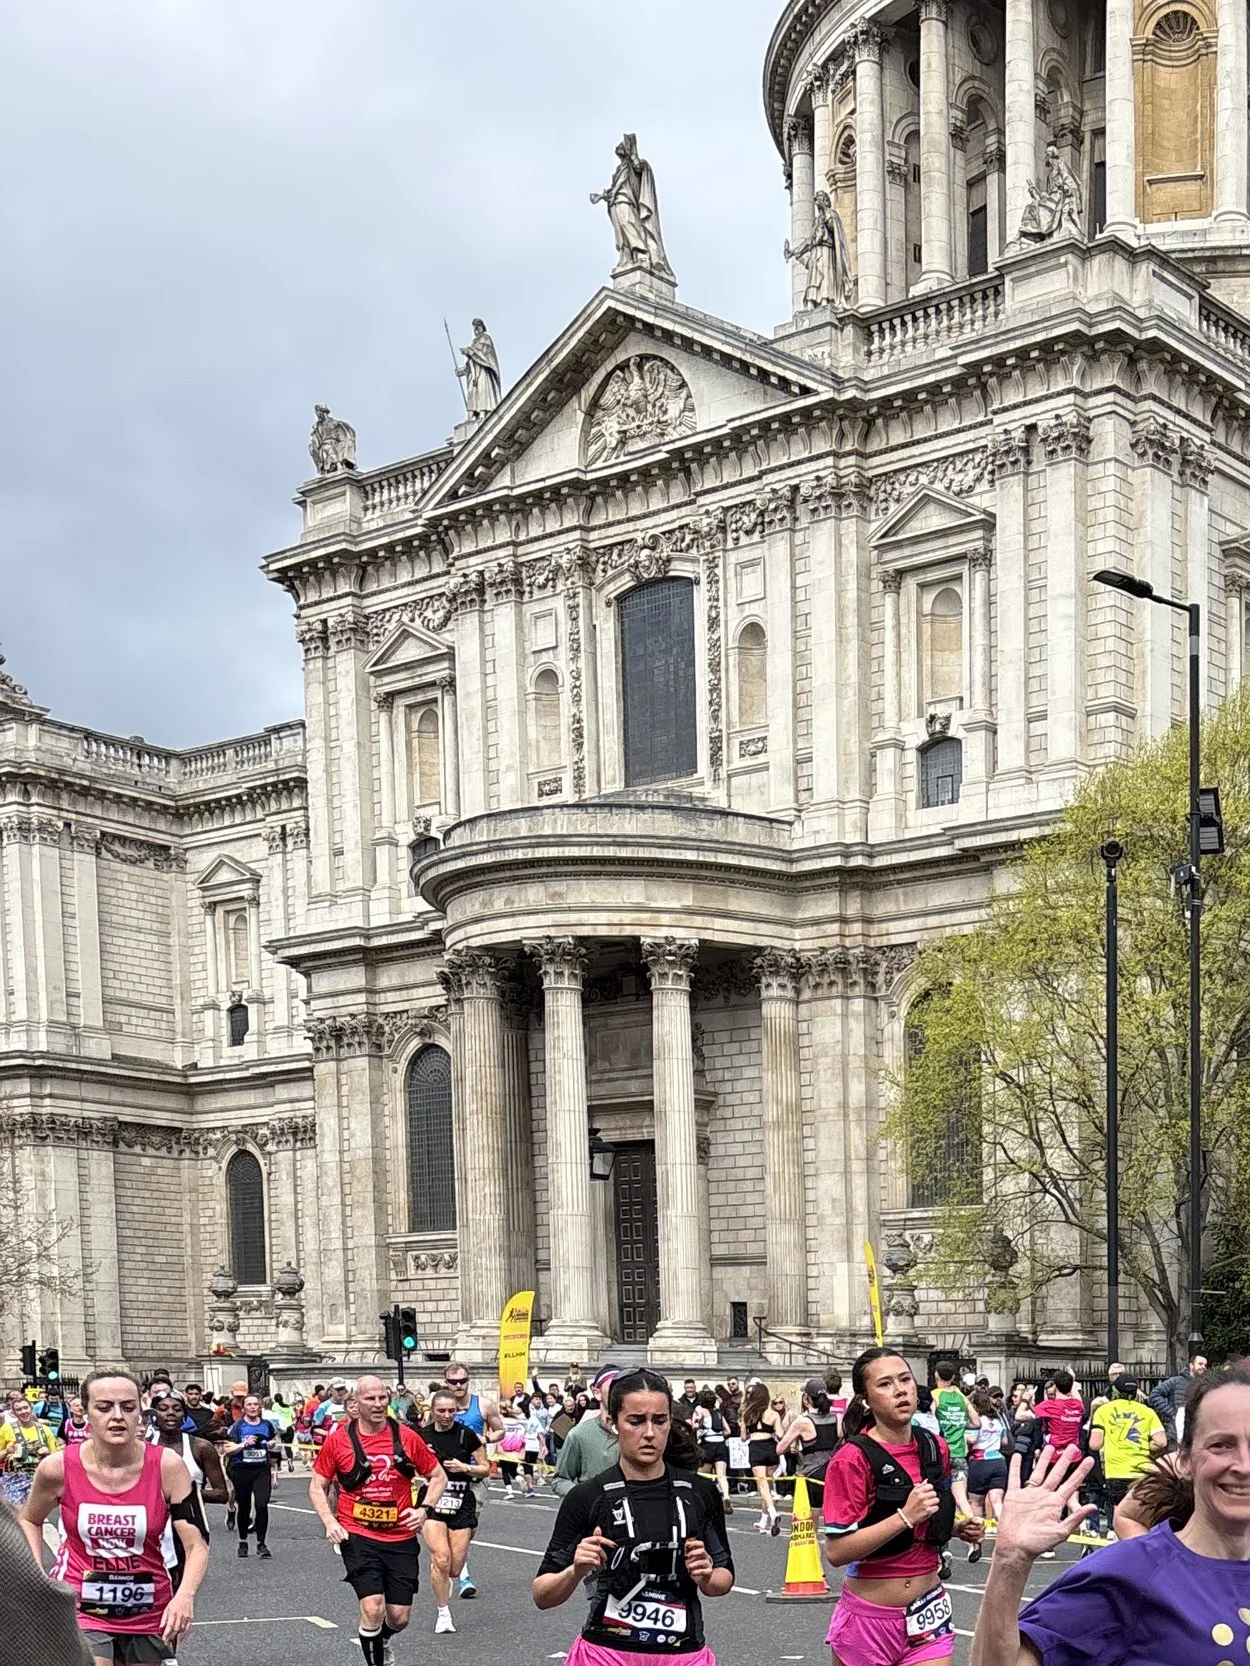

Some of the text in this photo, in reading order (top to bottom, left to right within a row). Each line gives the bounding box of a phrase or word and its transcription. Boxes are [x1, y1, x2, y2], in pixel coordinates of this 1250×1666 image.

[87, 1513, 137, 1526] BREAST
[360, 1507, 390, 1520] 4321
[87, 1526, 137, 1538] CANCER
[93, 1556, 143, 1572] ELLIE
[95, 1585, 146, 1603] 1196
[618, 1602, 676, 1628] 9946
[916, 1598, 951, 1630] 9958
